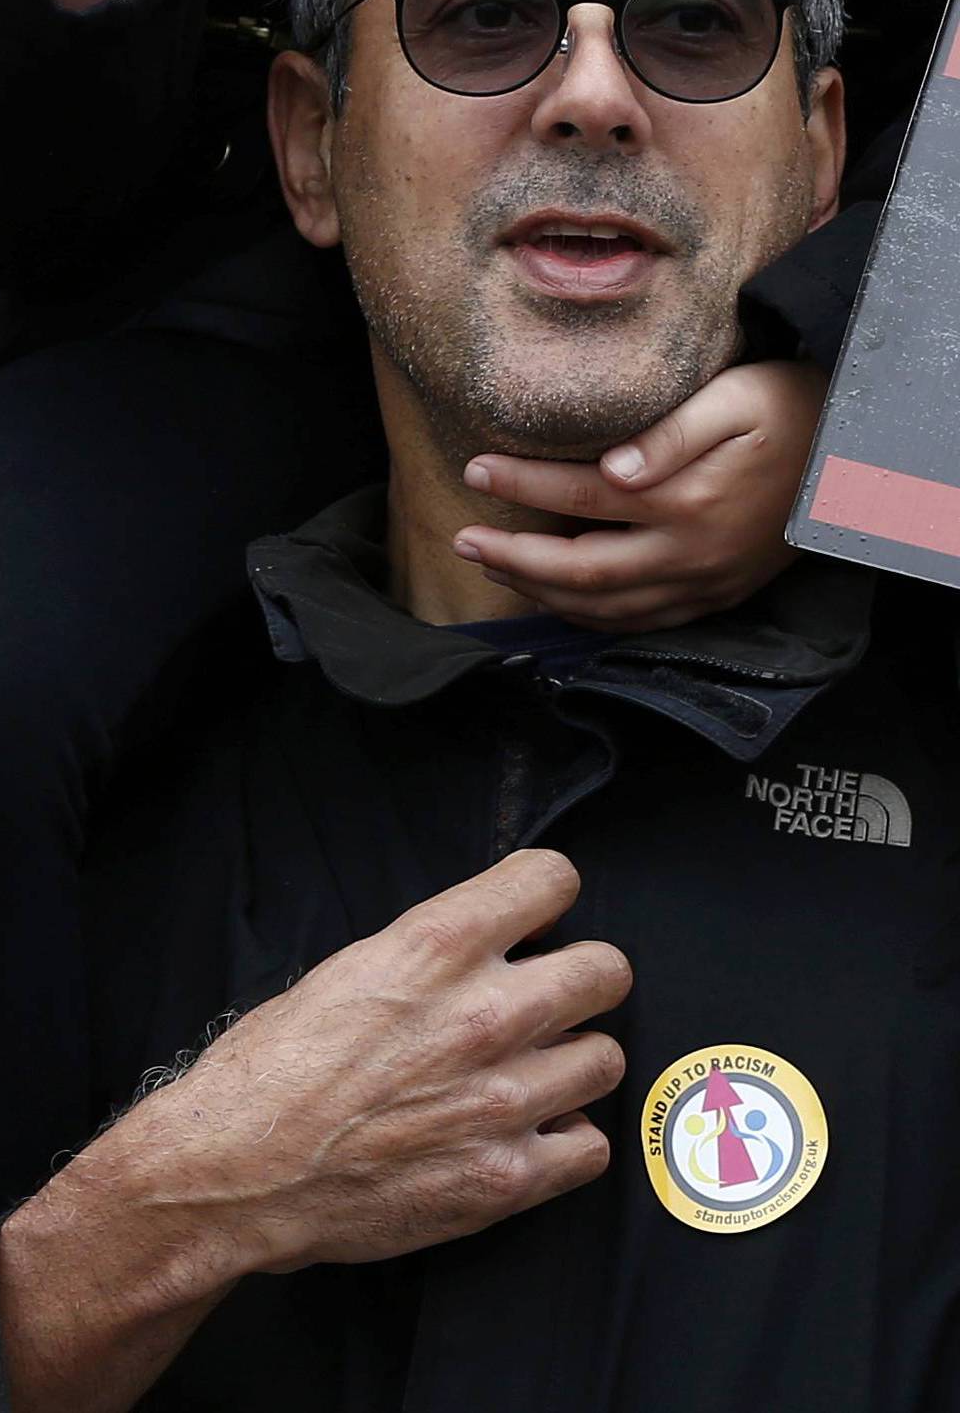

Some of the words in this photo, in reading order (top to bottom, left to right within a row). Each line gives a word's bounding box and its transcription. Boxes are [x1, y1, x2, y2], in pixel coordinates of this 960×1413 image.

[744, 773, 858, 816] NORTH
[796, 763, 859, 794] THE
[773, 807, 855, 841] FACE
[649, 1100, 667, 1156] STAND
[663, 1078, 682, 1100] UP
[683, 1063, 706, 1082] TO
[711, 1056, 776, 1078] RACISM
[694, 1139, 819, 1226] standuptoracism.org.uk
